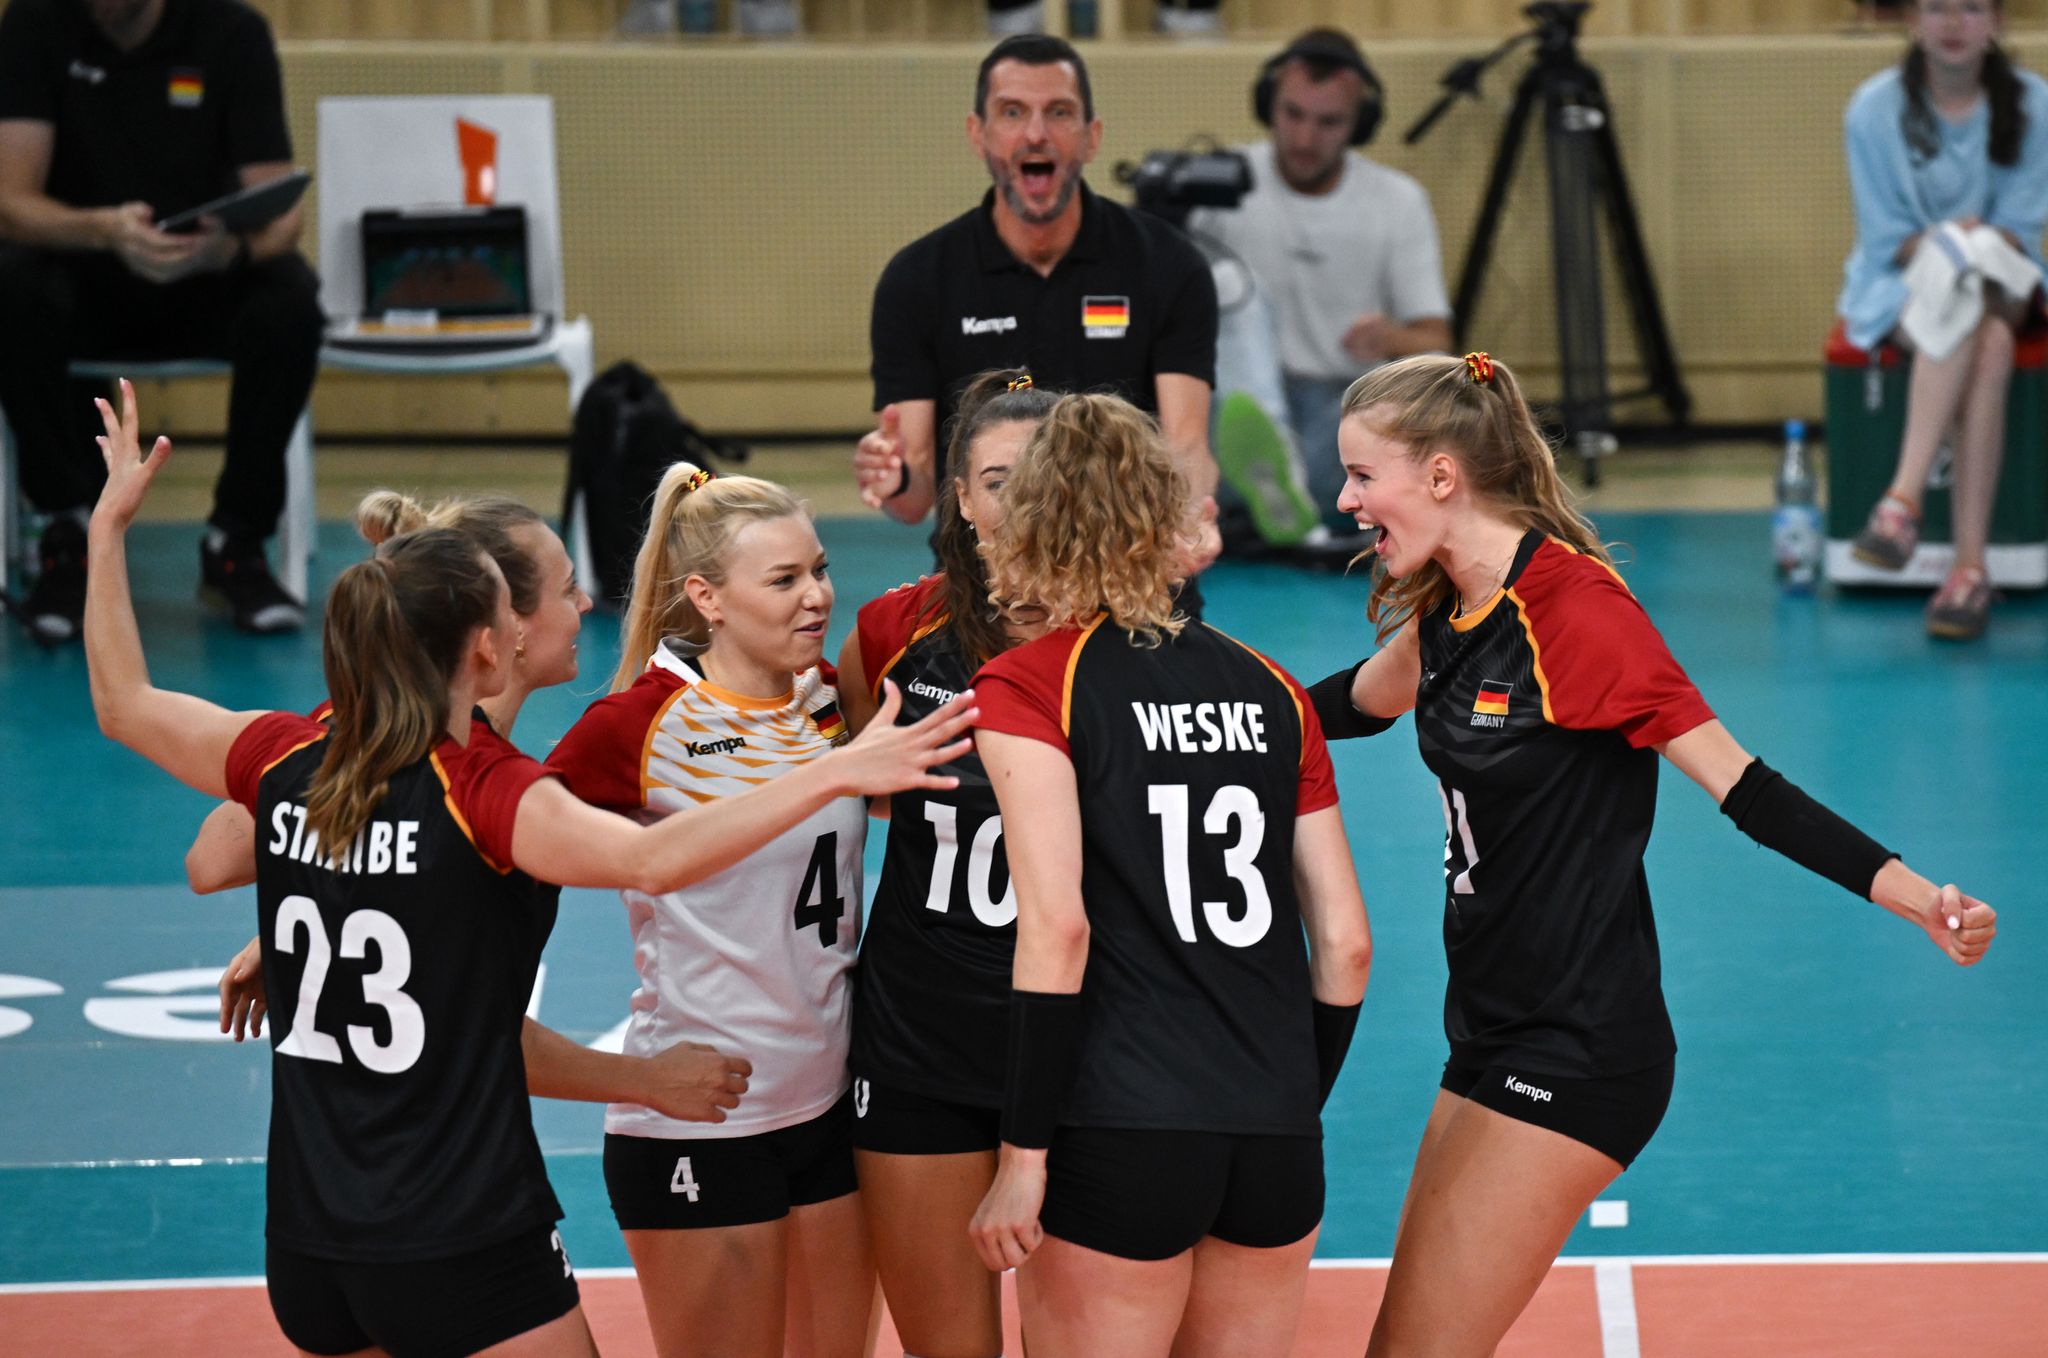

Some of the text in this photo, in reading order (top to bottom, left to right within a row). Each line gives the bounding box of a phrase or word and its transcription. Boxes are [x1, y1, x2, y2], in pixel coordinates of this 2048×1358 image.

[1131, 701, 1268, 753] WESKE
[1470, 713, 1506, 728] GERMANY
[685, 737, 747, 757] Kempa
[924, 800, 1018, 927] 10
[1148, 784, 1273, 948] 13
[794, 831, 845, 949] 4
[275, 895, 426, 1074] 23
[1504, 1075, 1553, 1102] Kempa
[670, 1156, 700, 1203] 4
